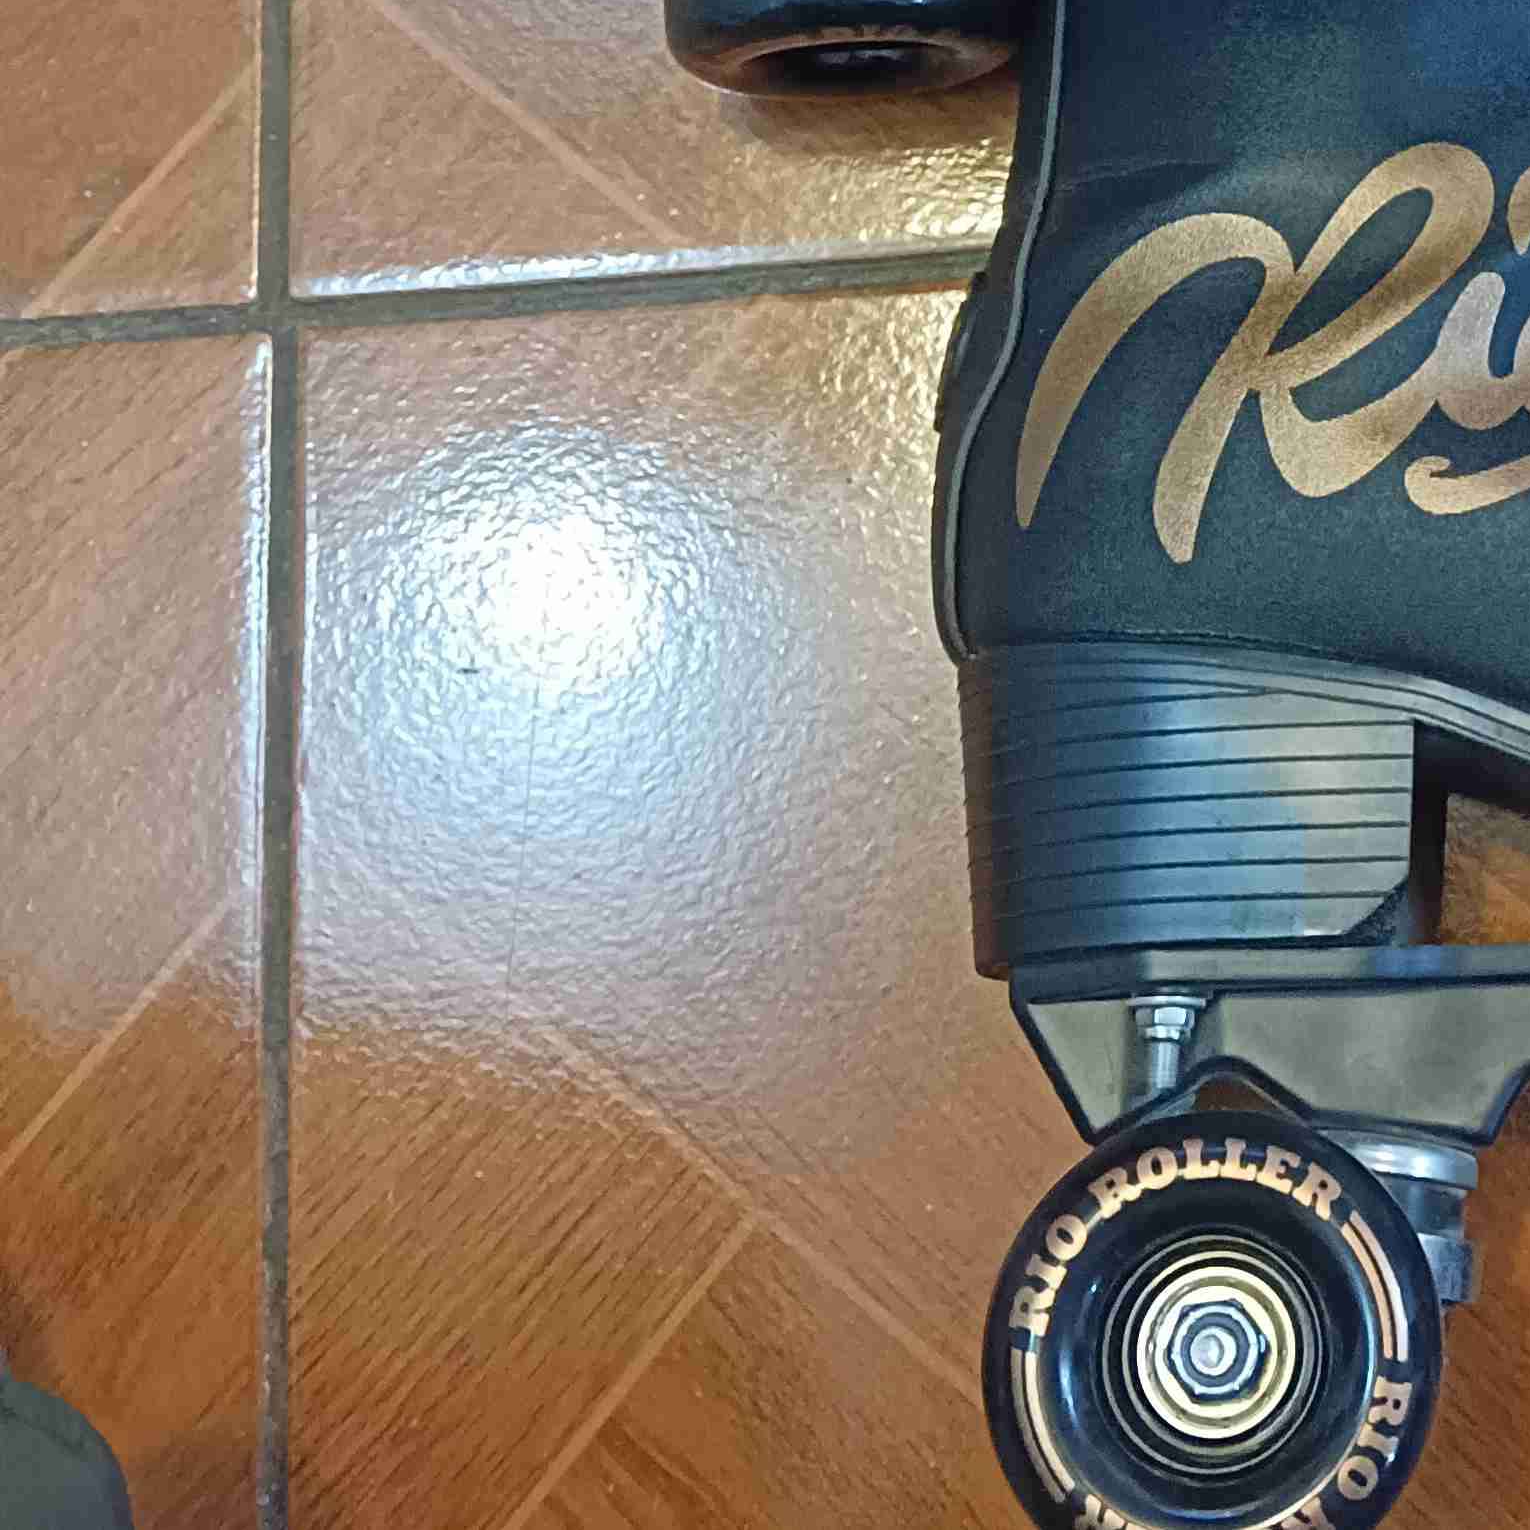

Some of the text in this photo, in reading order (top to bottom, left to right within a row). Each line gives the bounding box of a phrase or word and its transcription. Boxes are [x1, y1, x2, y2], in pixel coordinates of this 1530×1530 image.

[1009, 1139, 1342, 1337] RIO ROLLER
[1337, 1375, 1413, 1500] RIO
